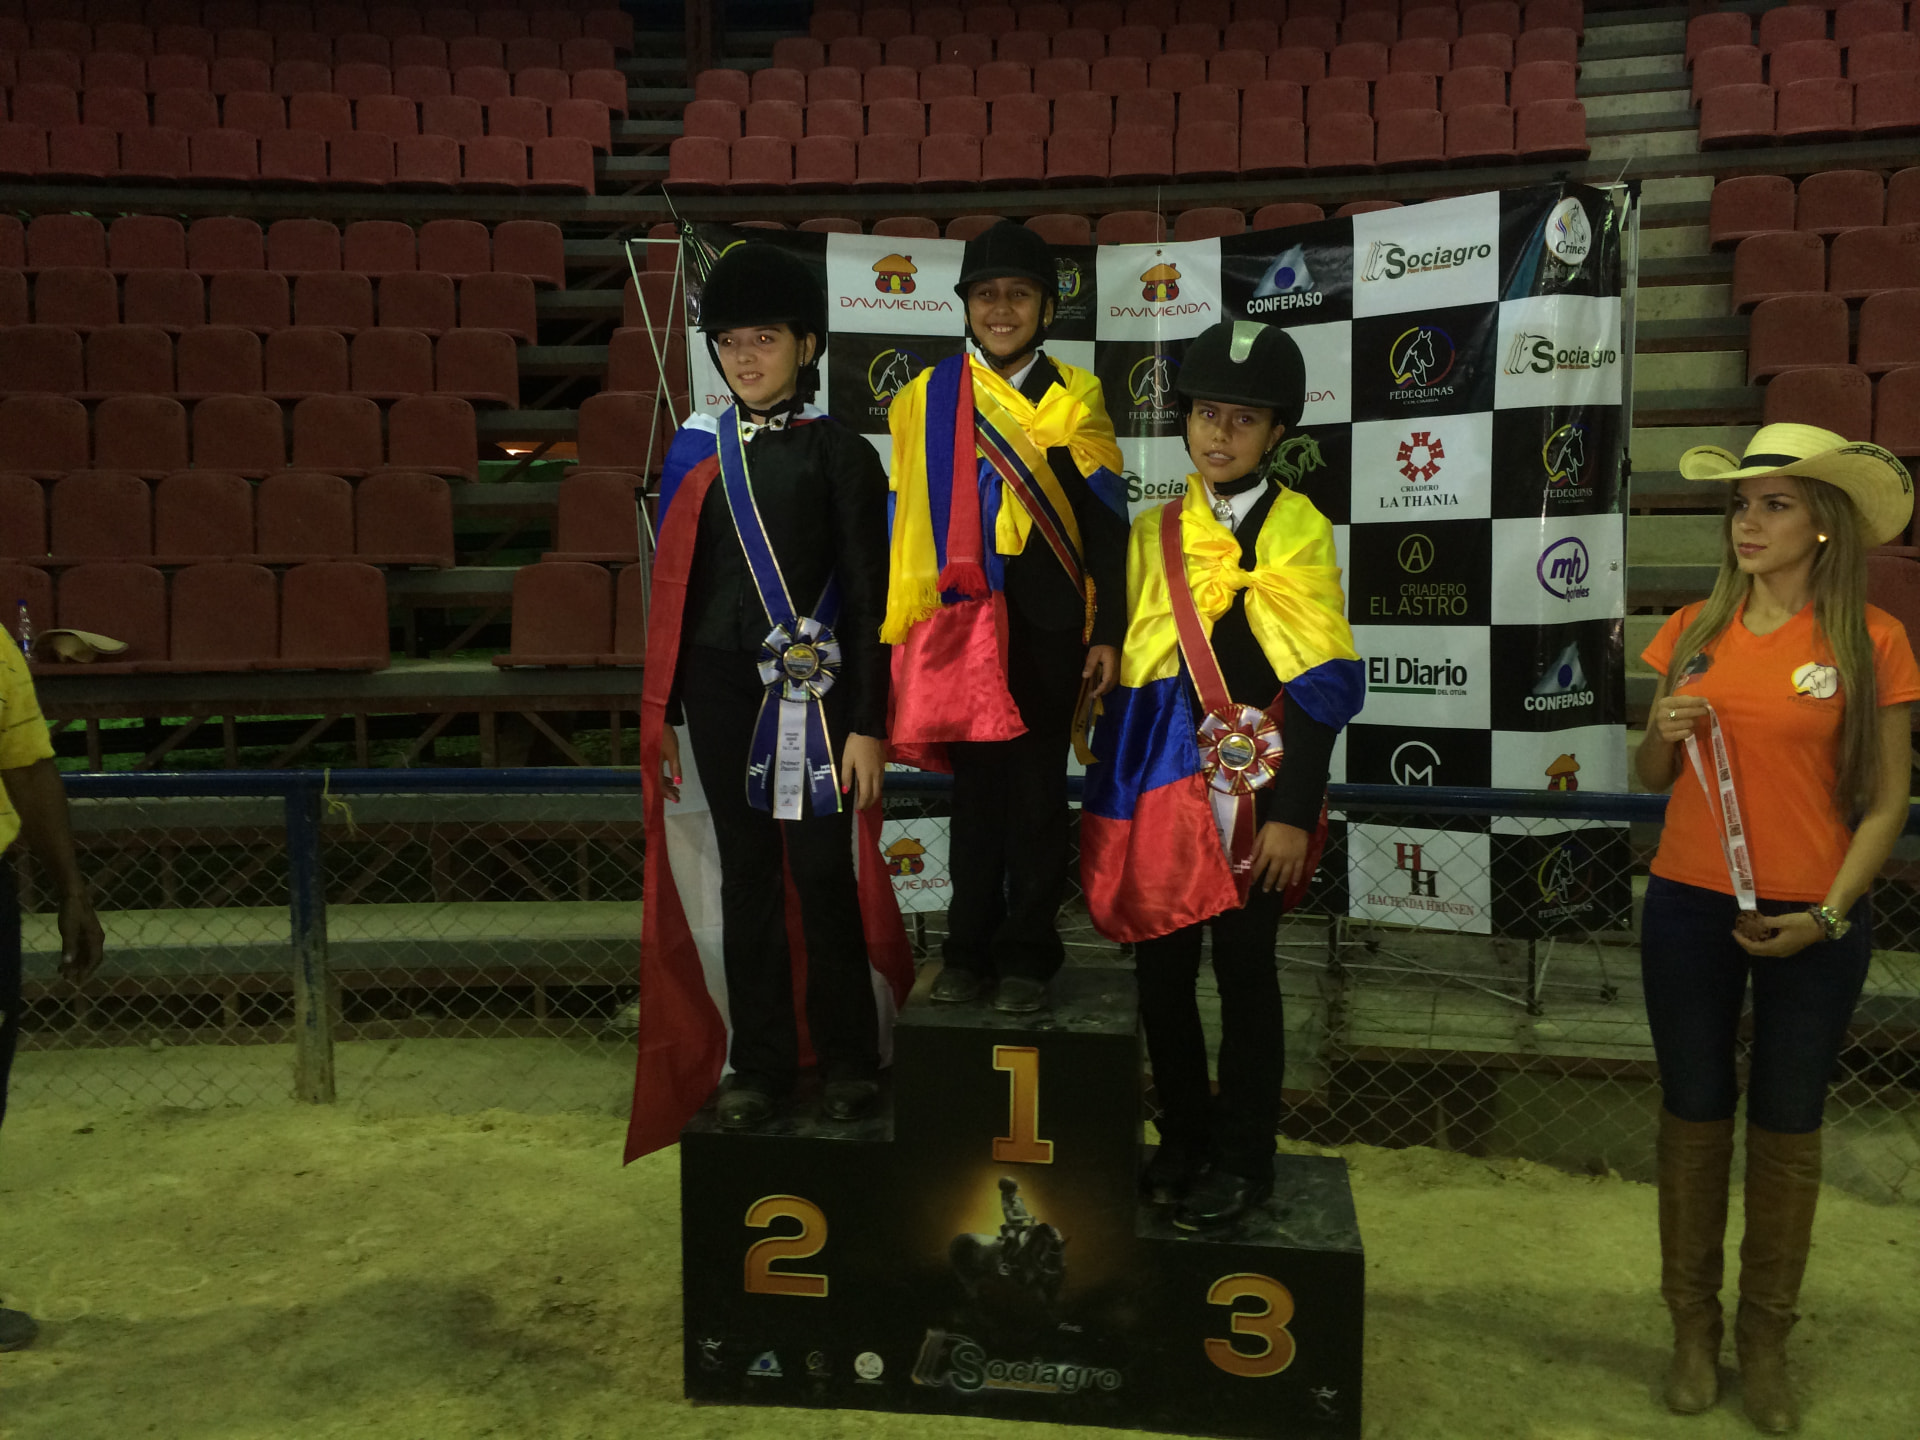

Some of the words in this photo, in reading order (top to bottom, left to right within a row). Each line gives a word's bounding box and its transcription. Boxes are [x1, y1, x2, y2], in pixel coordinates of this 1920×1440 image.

[1555, 240, 1587, 255] Crines
[1384, 243, 1491, 280] Sociagro
[839, 296, 953, 312] DAVIVIENDA
[1109, 302, 1211, 318] DAVIVIENDA
[1246, 291, 1323, 315] CONFEPASO
[1530, 340, 1616, 374] Sociagro
[1389, 385, 1455, 401] FEDEQUINAS
[1400, 484, 1440, 493] CRIADERO
[1379, 496, 1400, 509] LA
[1401, 493, 1459, 508] THANIA
[1399, 583, 1468, 597] CRIADERO
[1369, 596, 1393, 616] EL
[1396, 596, 1469, 616] ASTRO
[1368, 657, 1390, 684] El
[1395, 657, 1468, 687] Diario
[1524, 690, 1594, 712] CONFEPASO
[1367, 893, 1425, 911] HACIENDA
[992, 1044, 1055, 1165] 1
[744, 1194, 829, 1298] 2
[1204, 1272, 1297, 1378] 3
[950, 1342, 1122, 1394] Sociagro
